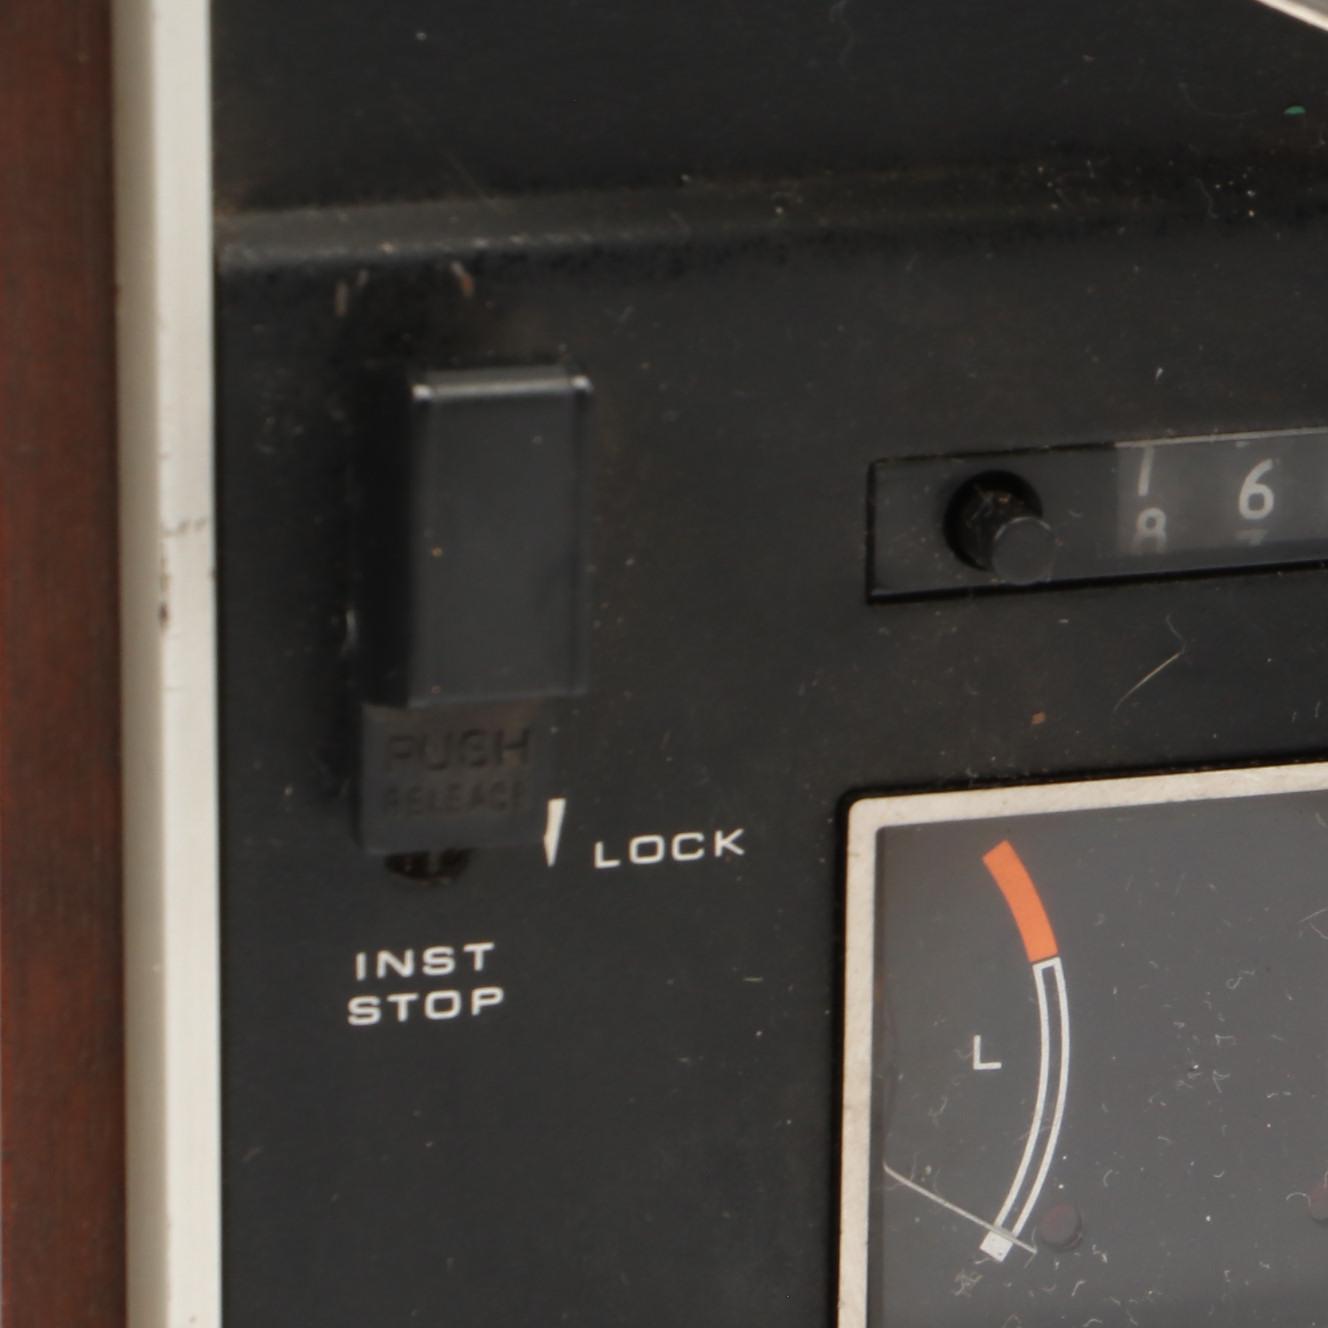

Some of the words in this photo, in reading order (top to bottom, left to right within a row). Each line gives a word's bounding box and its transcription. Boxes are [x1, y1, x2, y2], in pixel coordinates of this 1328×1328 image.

[594, 828, 744, 869] LOCK
[356, 942, 494, 980] INST
[348, 986, 504, 1026] STOP
[972, 1034, 1002, 1071] L
